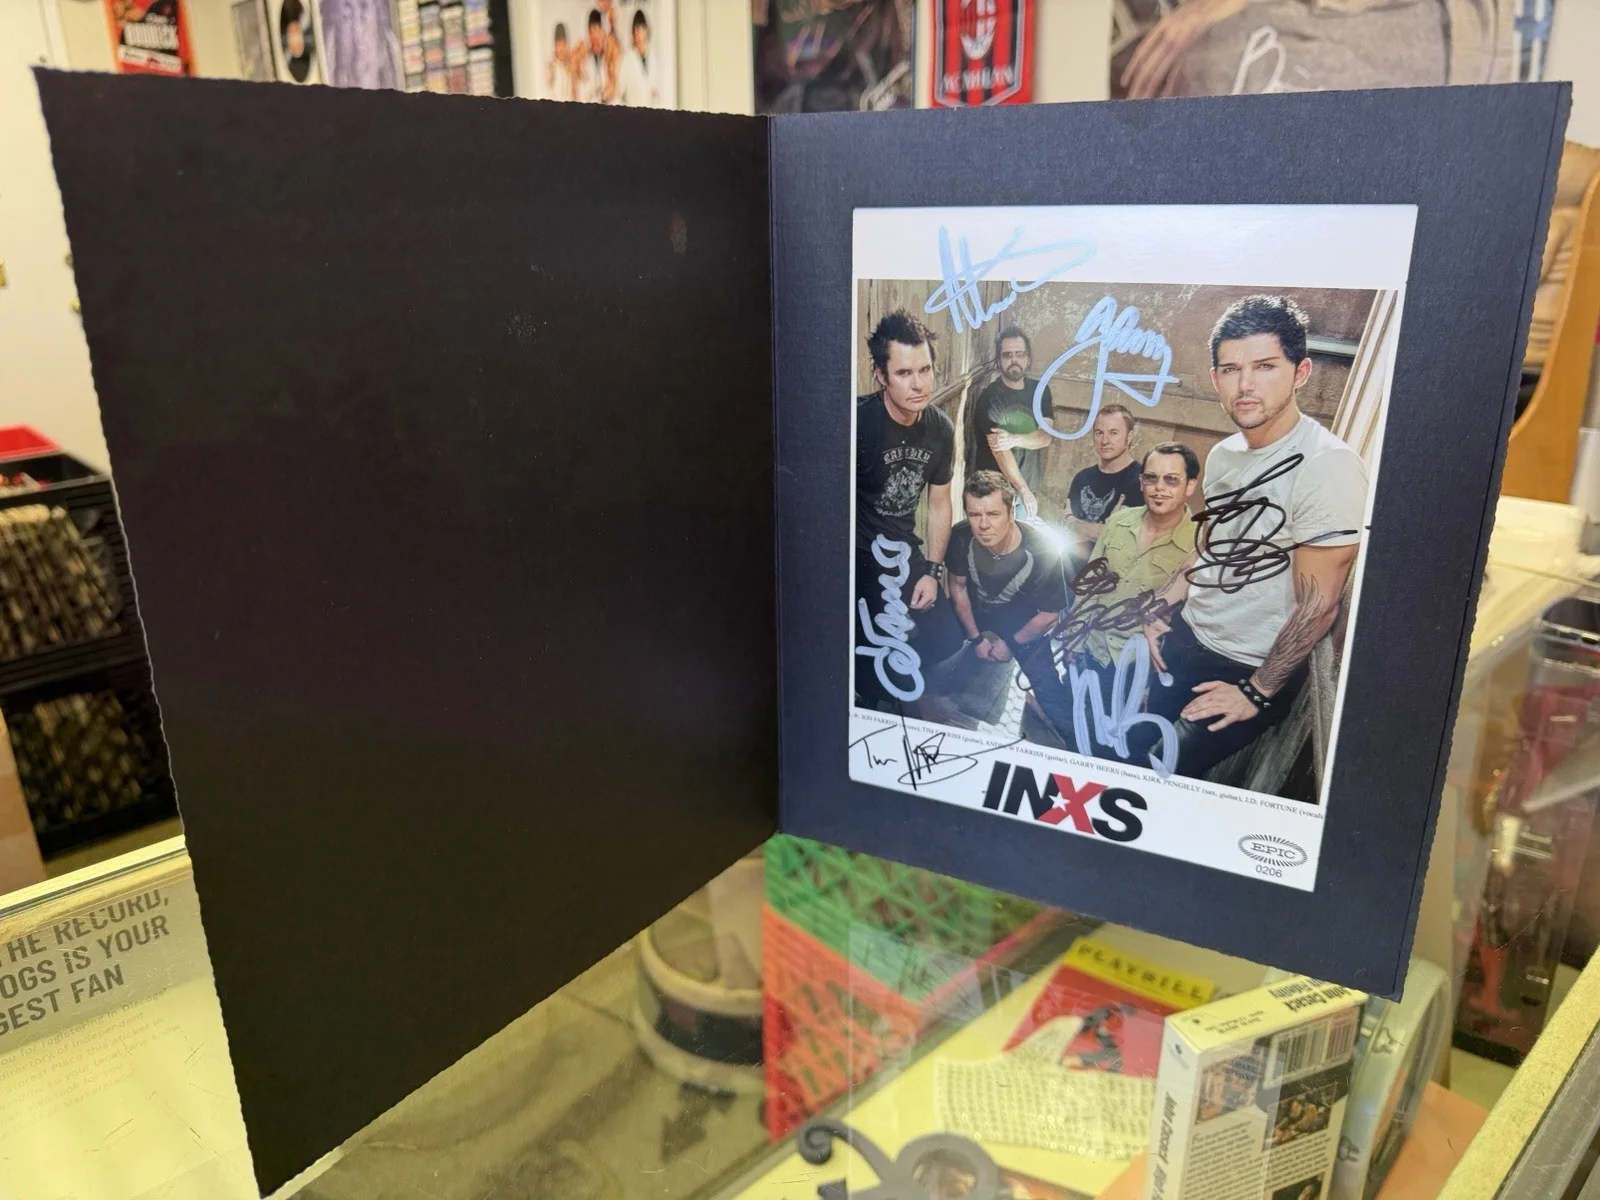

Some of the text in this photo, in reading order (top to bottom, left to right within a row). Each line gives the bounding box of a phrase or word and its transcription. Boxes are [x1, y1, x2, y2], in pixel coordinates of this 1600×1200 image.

[982, 760, 1148, 842] INXS
[986, 740, 1015, 752] ANDRW
[1015, 747, 1044, 758] FARRISS
[1044, 753, 1069, 765] (guitar),
[1069, 759, 1095, 770] GARRY
[1096, 765, 1120, 775] BEERS
[1120, 770, 1141, 781] (bass),
[1142, 774, 1162, 784] KIRK
[1162, 778, 1202, 793] PENGILLY
[1219, 791, 1243, 803] guitar),
[1244, 797, 1258, 806] J.D.
[1259, 800, 1298, 814] FORTUNE
[1298, 808, 1324, 820] (vocals
[1250, 841, 1296, 860] EPIC
[1255, 864, 1283, 878] 0206
[0, 889, 170, 967] HE RECORD,
[97, 915, 170, 960] YOUR
[70, 964, 125, 1004] FAN
[57, 1044, 69, 1055] of
[73, 1012, 145, 1048] independent
[87, 1043, 107, 1056] this
